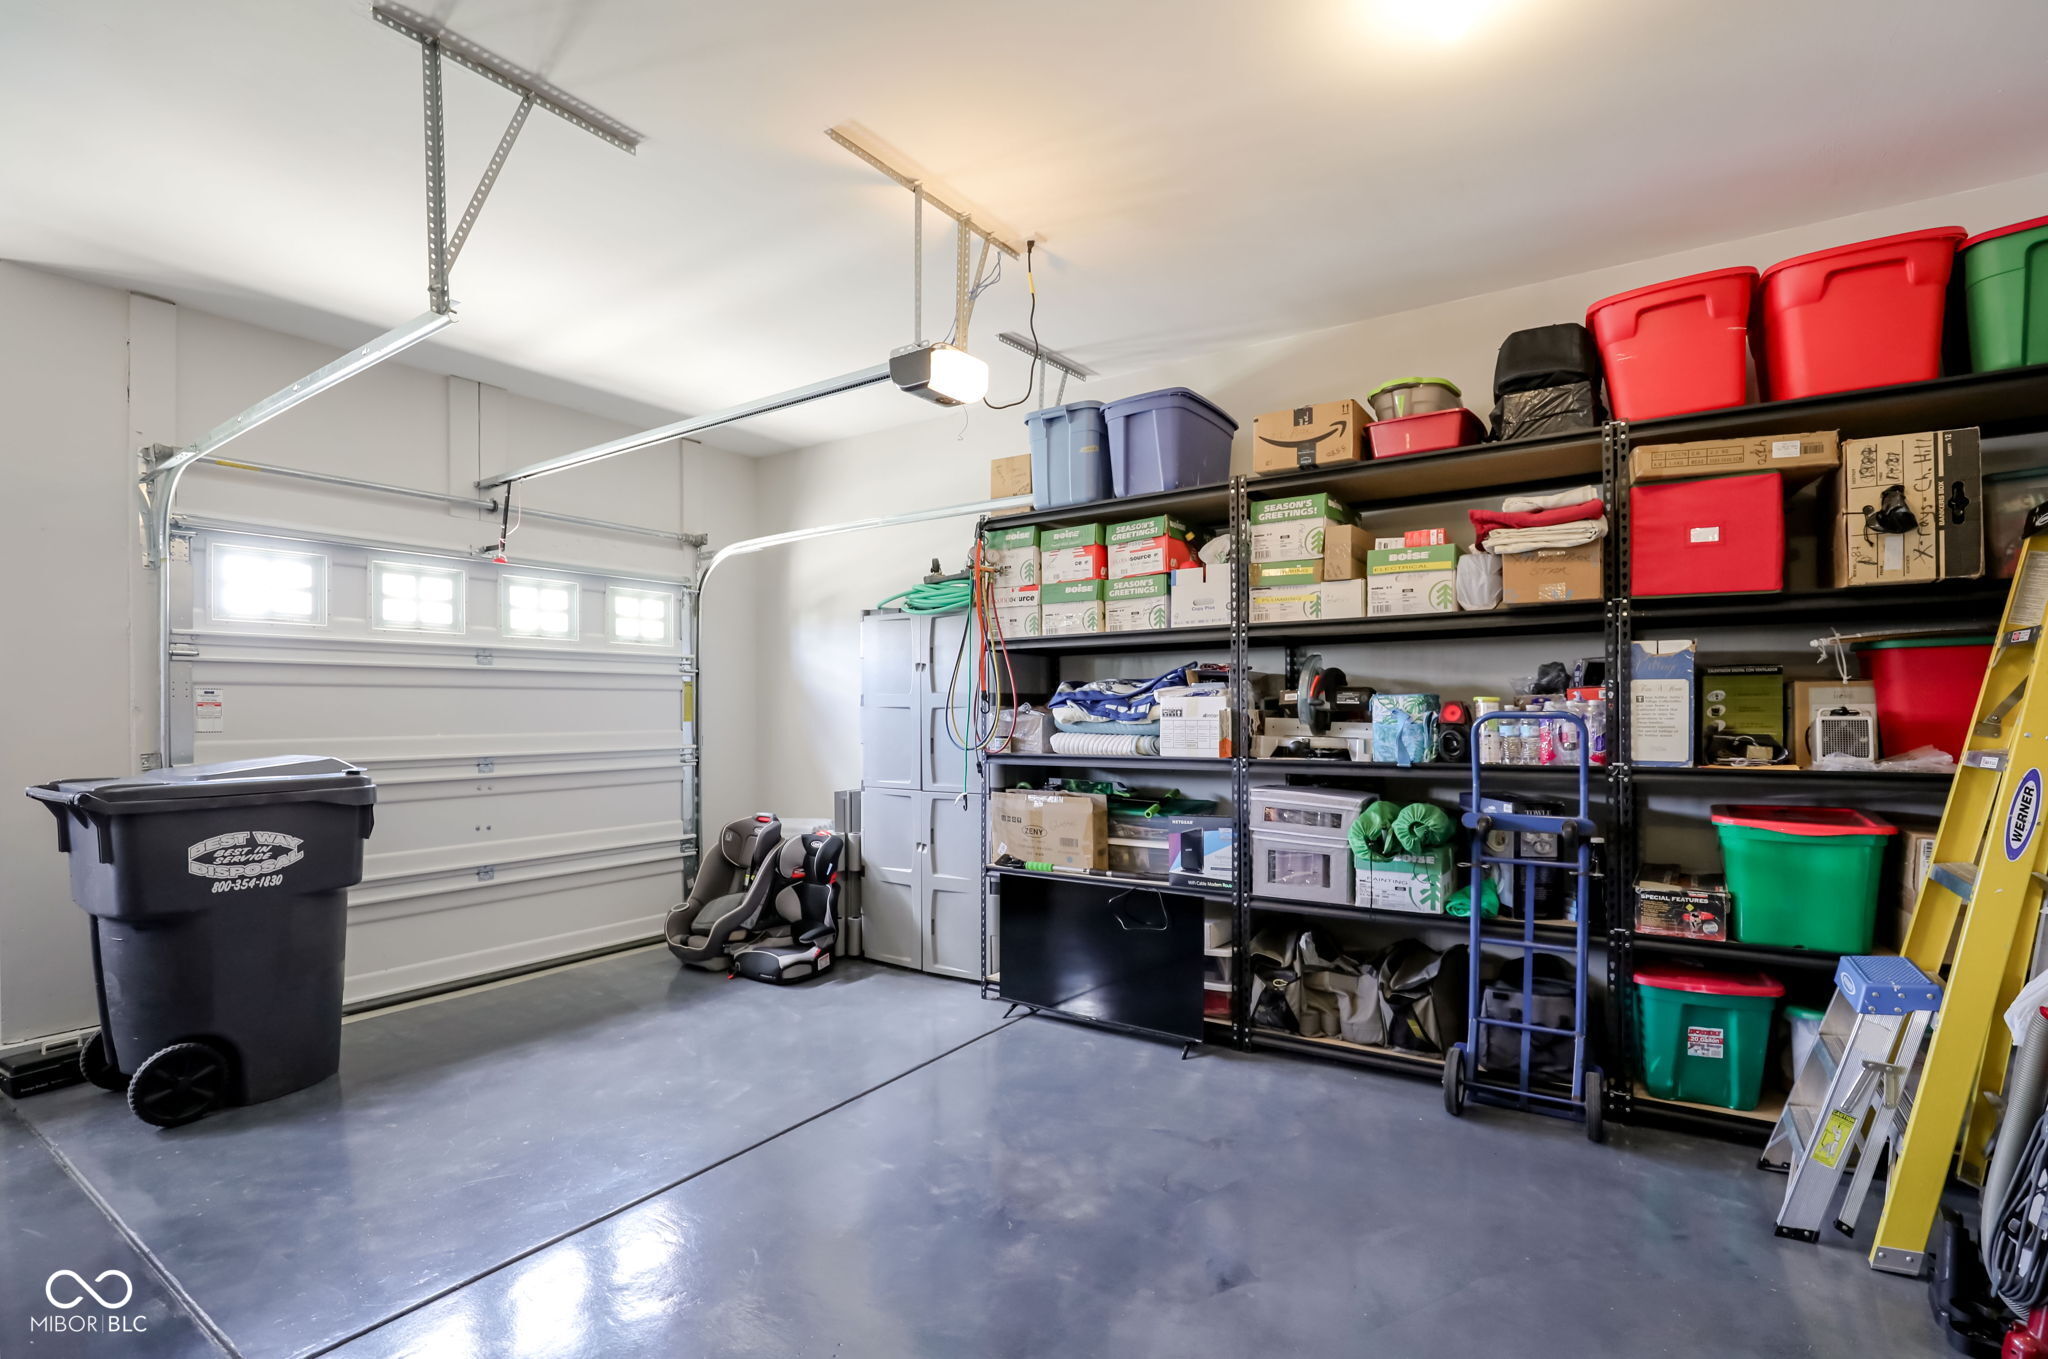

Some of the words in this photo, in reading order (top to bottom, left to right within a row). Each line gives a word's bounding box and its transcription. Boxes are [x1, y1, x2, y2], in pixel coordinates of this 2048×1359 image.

[1913, 439, 1932, 464] Hill
[1264, 499, 1312, 512] SEASON'S
[1258, 507, 1318, 520] GREETINGS!
[1112, 527, 1158, 540] GREETINGS!
[1116, 520, 1154, 534] SEASON'S
[1114, 578, 1154, 590] SEASON'S
[1109, 586, 1158, 597] GREETINGS!
[2012, 786, 2034, 843] WERNER
[1024, 828, 1044, 836] ZENY
[188, 831, 250, 861] BEST
[252, 831, 304, 850] WAY
[213, 847, 252, 858] BEST
[188, 850, 304, 878] DISPOSAL
[213, 852, 272, 864] SERVICE
[211, 874, 284, 894] 800-354-1830
[1640, 894, 1670, 902] SPECIAL
[1672, 896, 1708, 904] FEATURES
[1832, 1110, 1856, 1122] CAUTION
